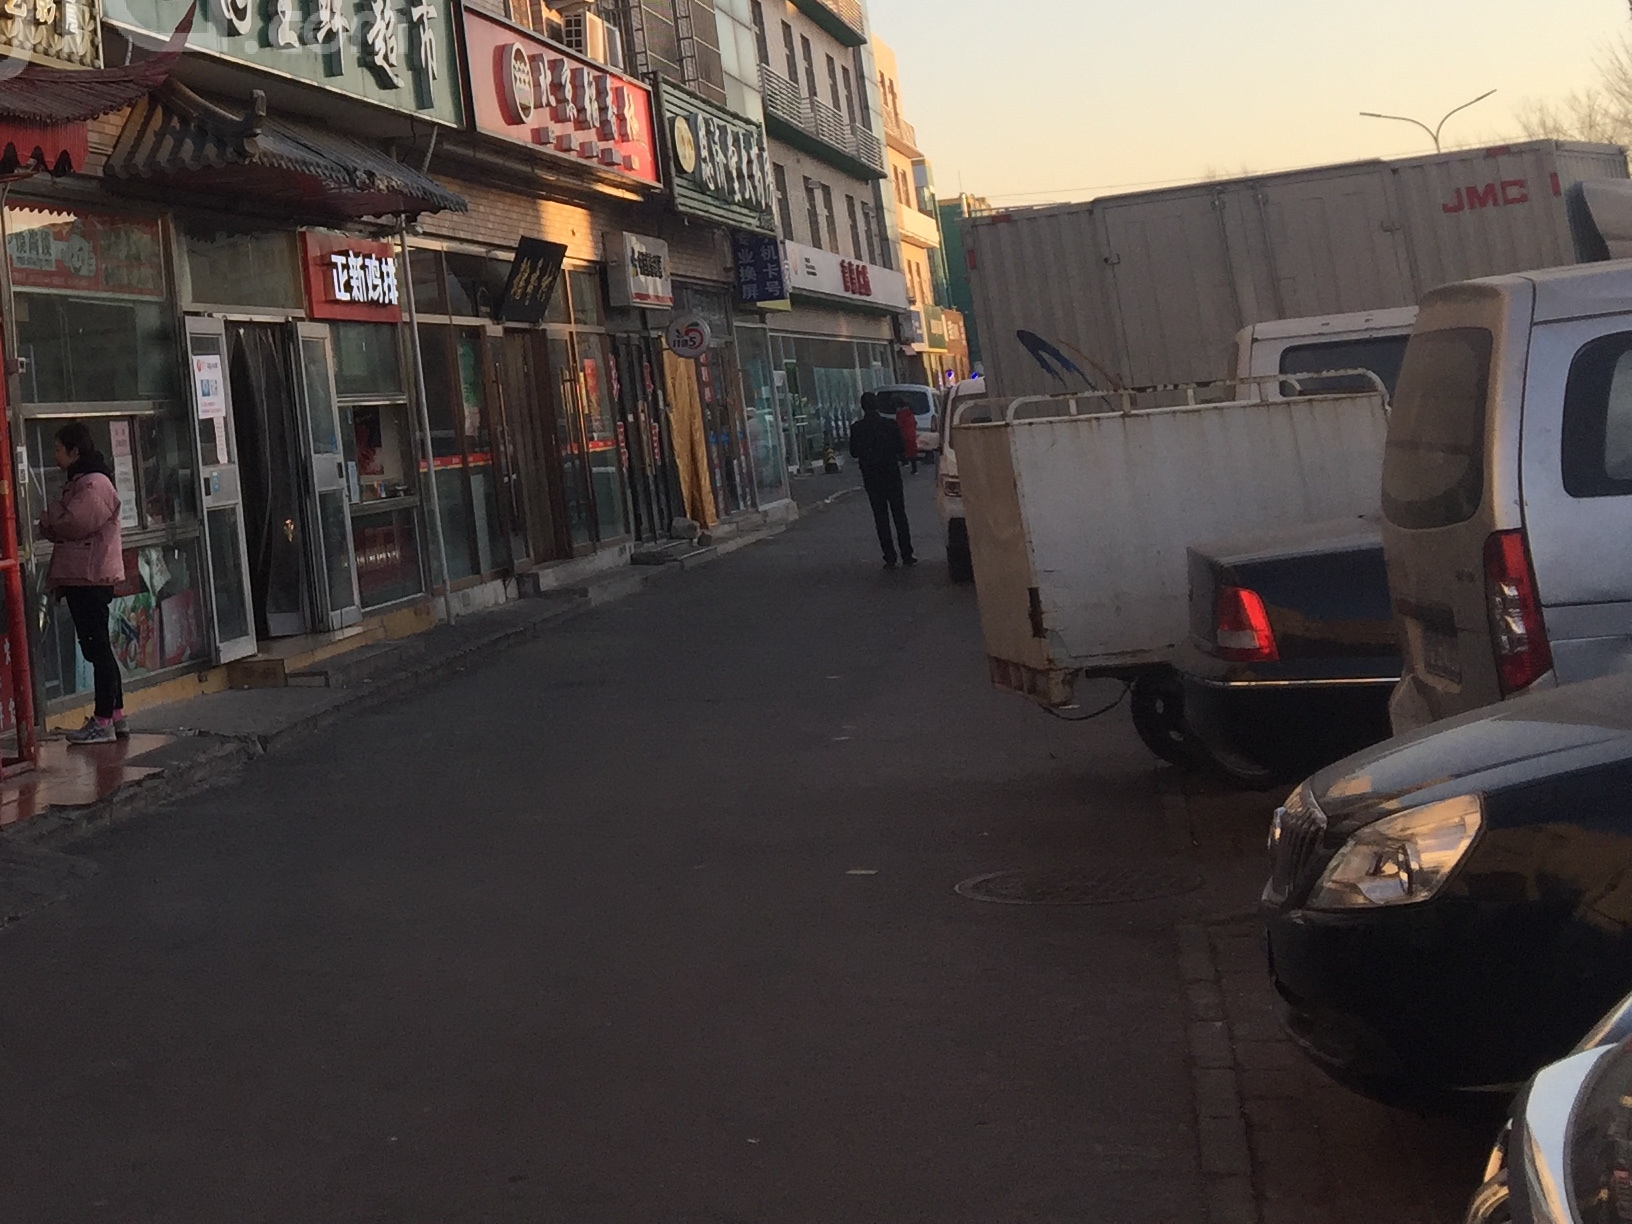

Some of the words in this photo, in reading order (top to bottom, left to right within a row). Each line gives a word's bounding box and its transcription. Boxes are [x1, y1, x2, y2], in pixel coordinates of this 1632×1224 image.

[1442, 179, 1529, 213] JMC
[331, 249, 400, 305] 正新鸡排
[760, 236, 782, 298] 机卡号
